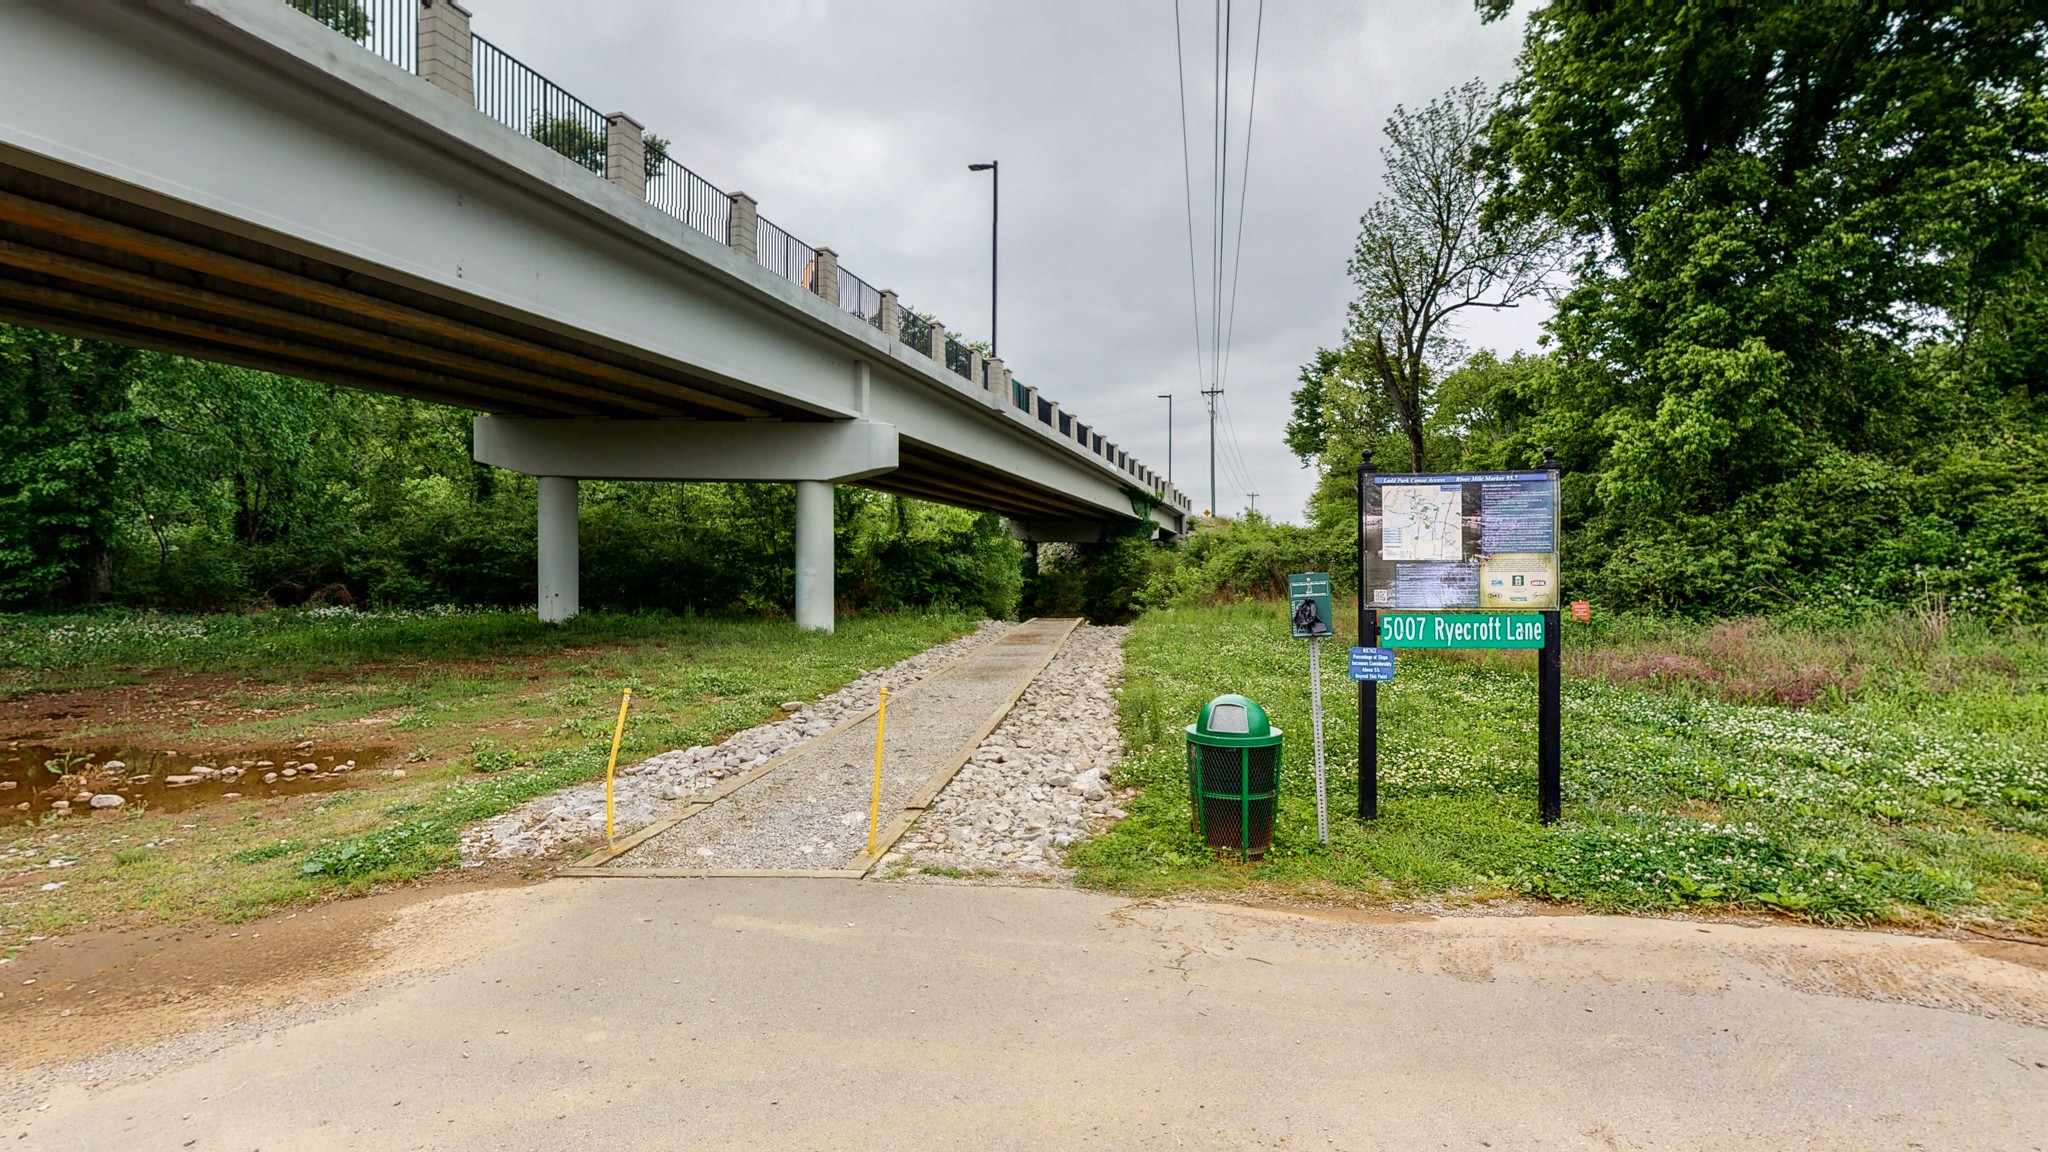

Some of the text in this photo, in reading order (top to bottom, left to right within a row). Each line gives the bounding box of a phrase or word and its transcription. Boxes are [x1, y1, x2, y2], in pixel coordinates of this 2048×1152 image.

[1383, 616, 1543, 647] 5007 Ryecroft Lane
